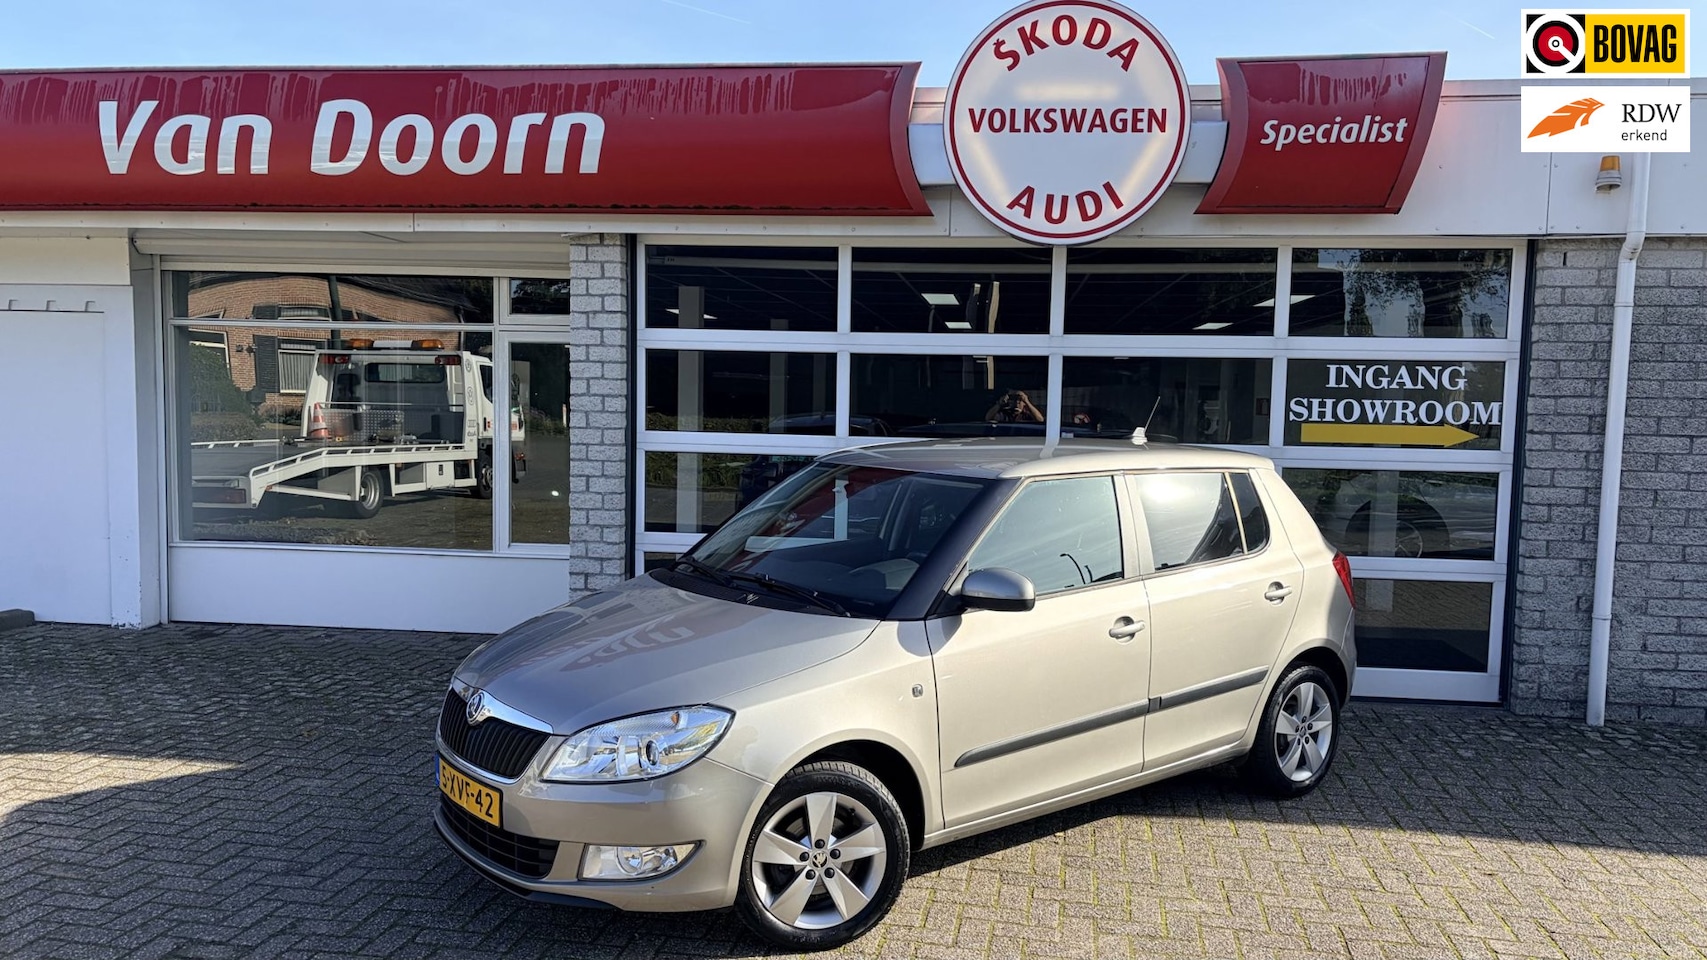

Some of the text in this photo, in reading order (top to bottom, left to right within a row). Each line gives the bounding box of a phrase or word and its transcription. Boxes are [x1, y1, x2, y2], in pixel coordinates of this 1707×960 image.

[993, 15, 1140, 71] ŠKODA
[99, 99, 605, 175] Van Doorn
[969, 109, 1167, 133] VOLKSWAGEN
[1260, 116, 1408, 150] Specialist
[1007, 181, 1124, 224] AUDI
[1326, 365, 1468, 390] INGANG
[1289, 398, 1503, 425] SHOWROOM
